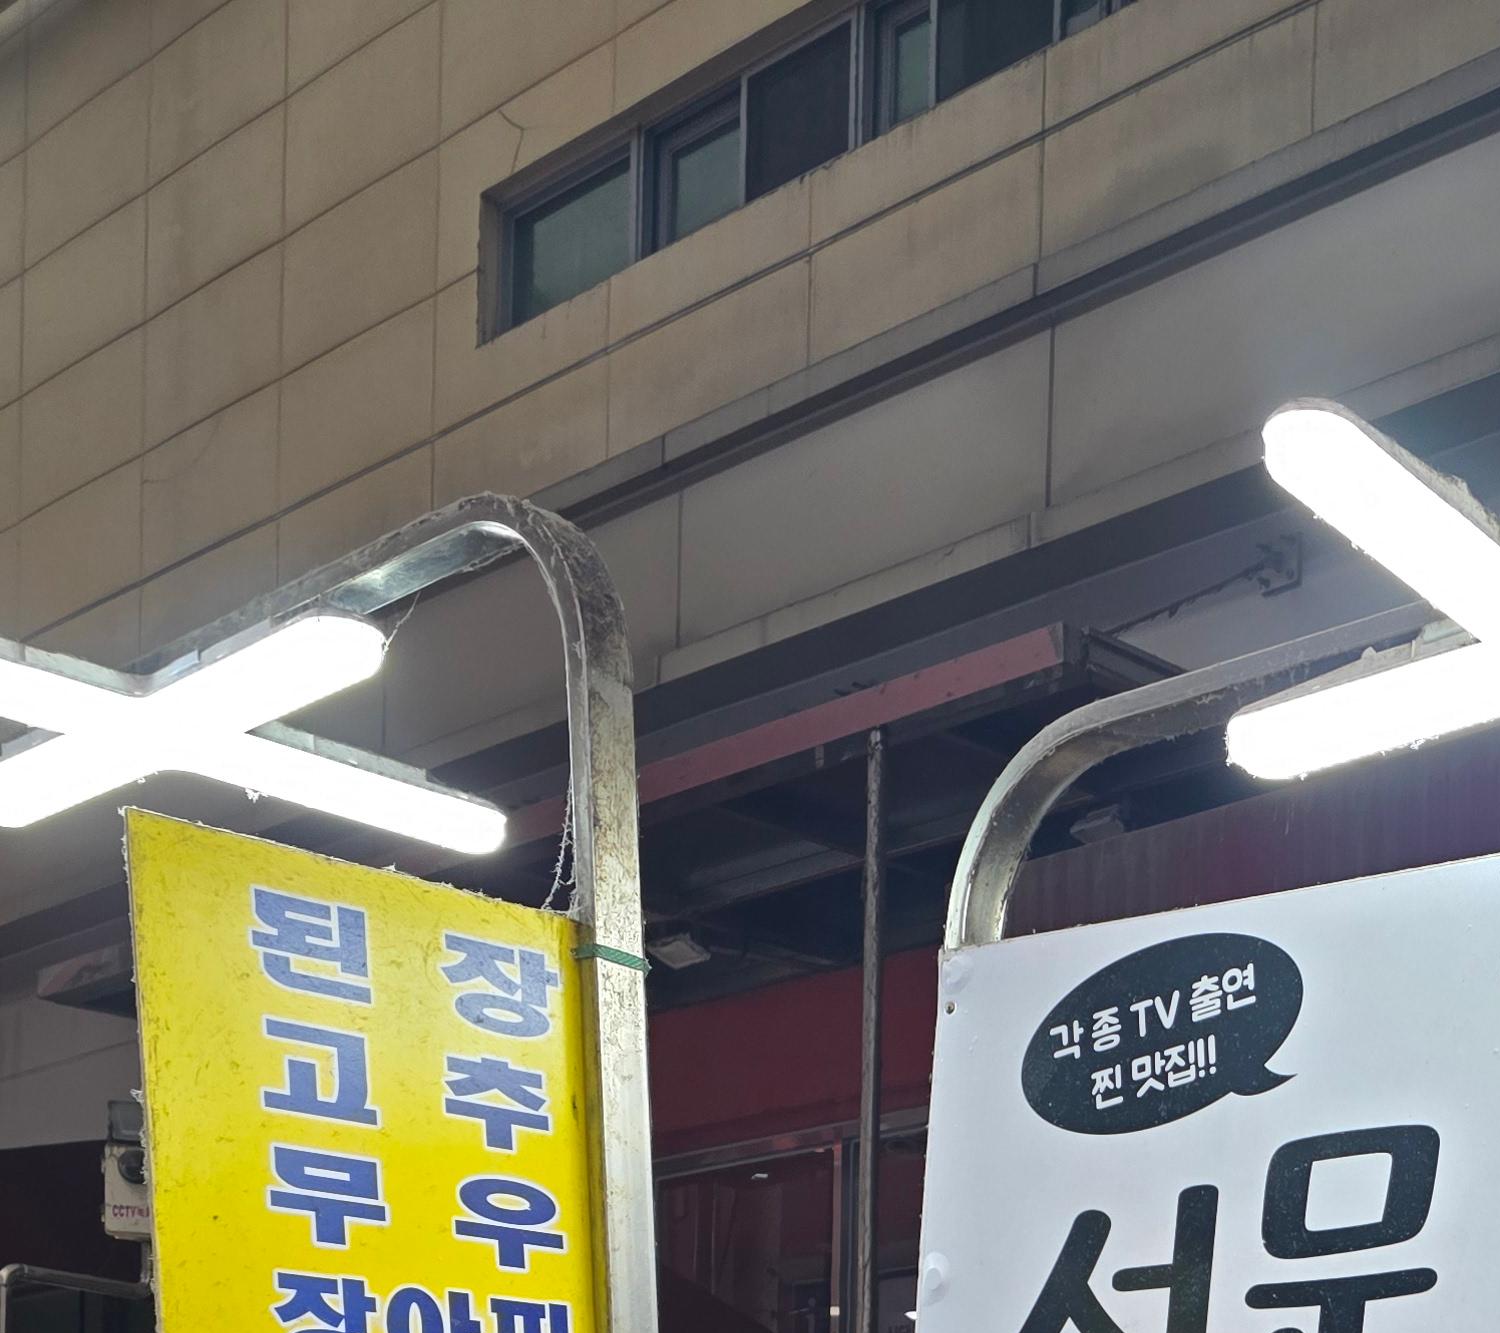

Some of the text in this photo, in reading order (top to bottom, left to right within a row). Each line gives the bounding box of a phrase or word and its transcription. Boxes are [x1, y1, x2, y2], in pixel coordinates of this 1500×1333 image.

[1130, 990, 1179, 1037] TV
[1189, 963, 1256, 1022] 출연
[1091, 1035, 1216, 1109] 찐 맛집!!
